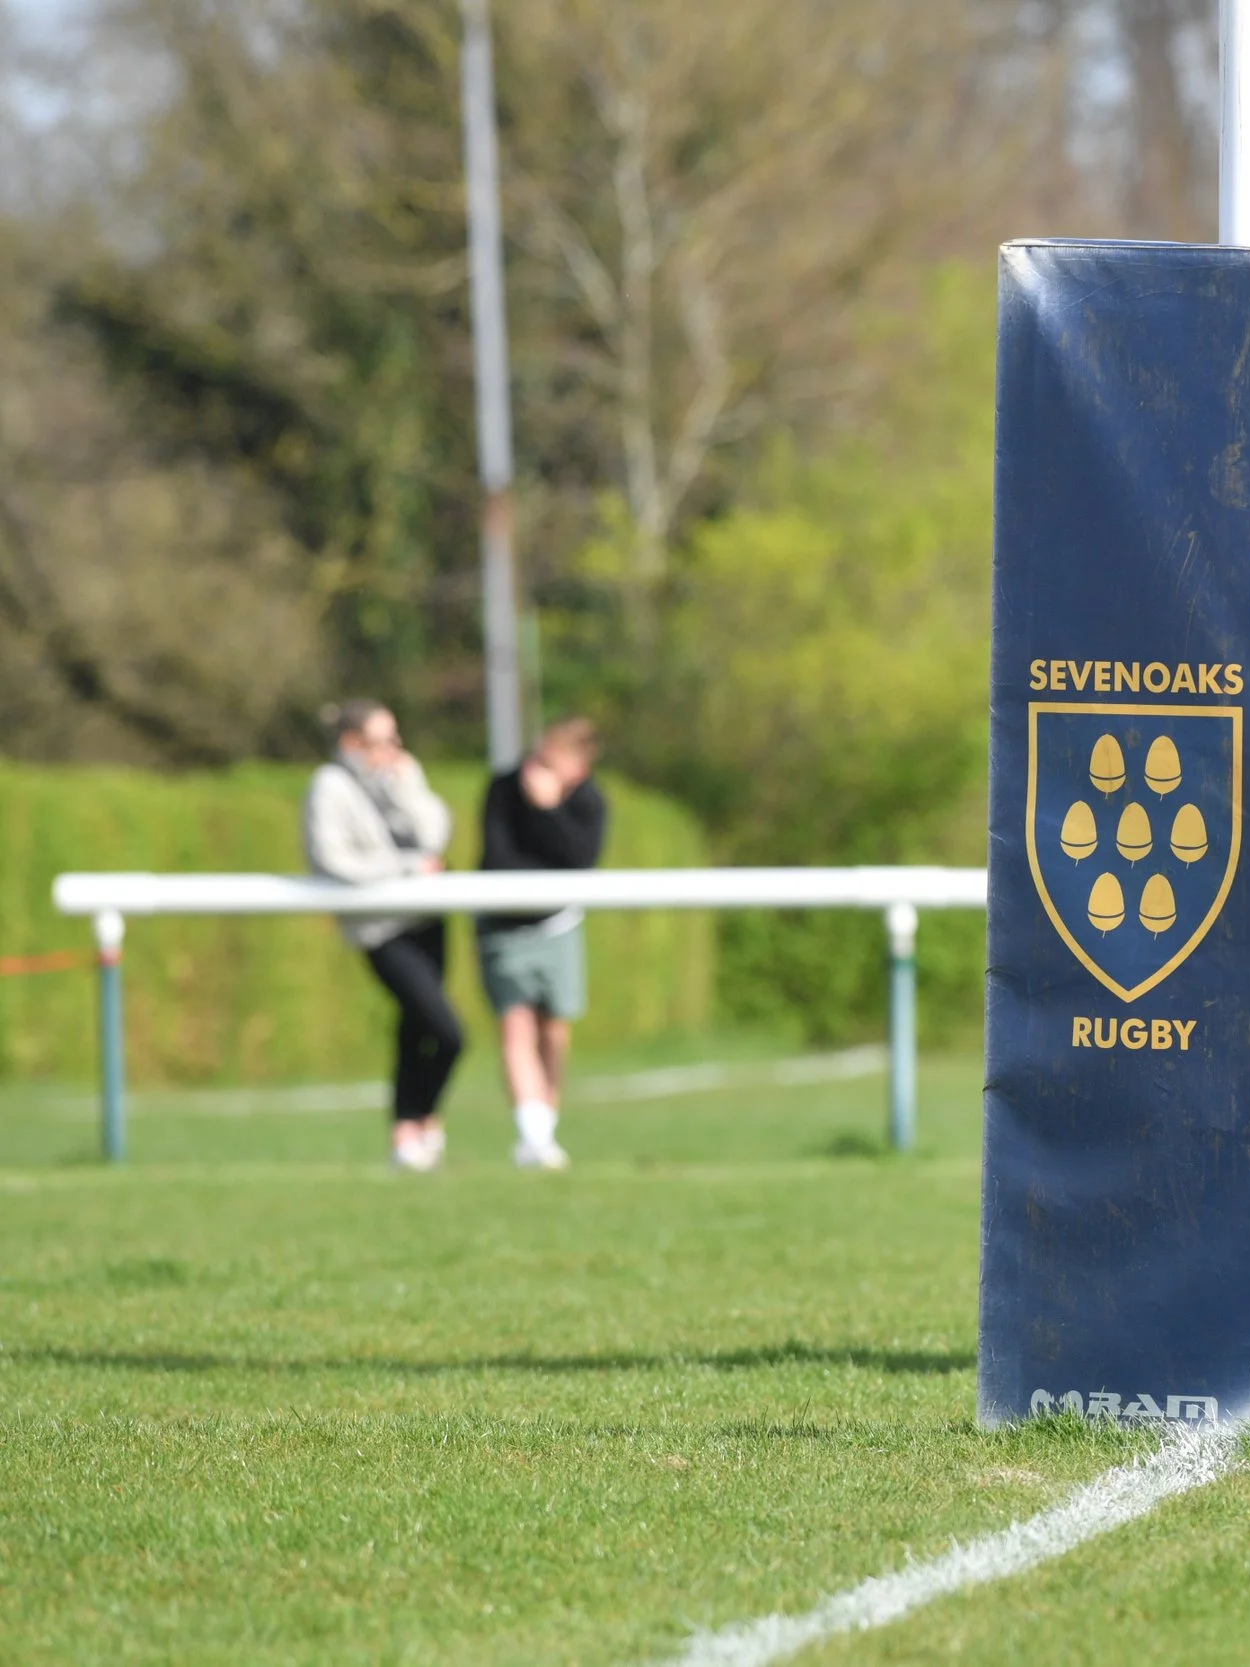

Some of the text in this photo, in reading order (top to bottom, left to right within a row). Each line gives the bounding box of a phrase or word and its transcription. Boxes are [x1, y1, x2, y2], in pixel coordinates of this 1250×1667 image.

[1029, 658, 1244, 695] SEVENOAKS
[1071, 1016, 1197, 1050] RUGBY
[1086, 1391, 1219, 1420] RAM
